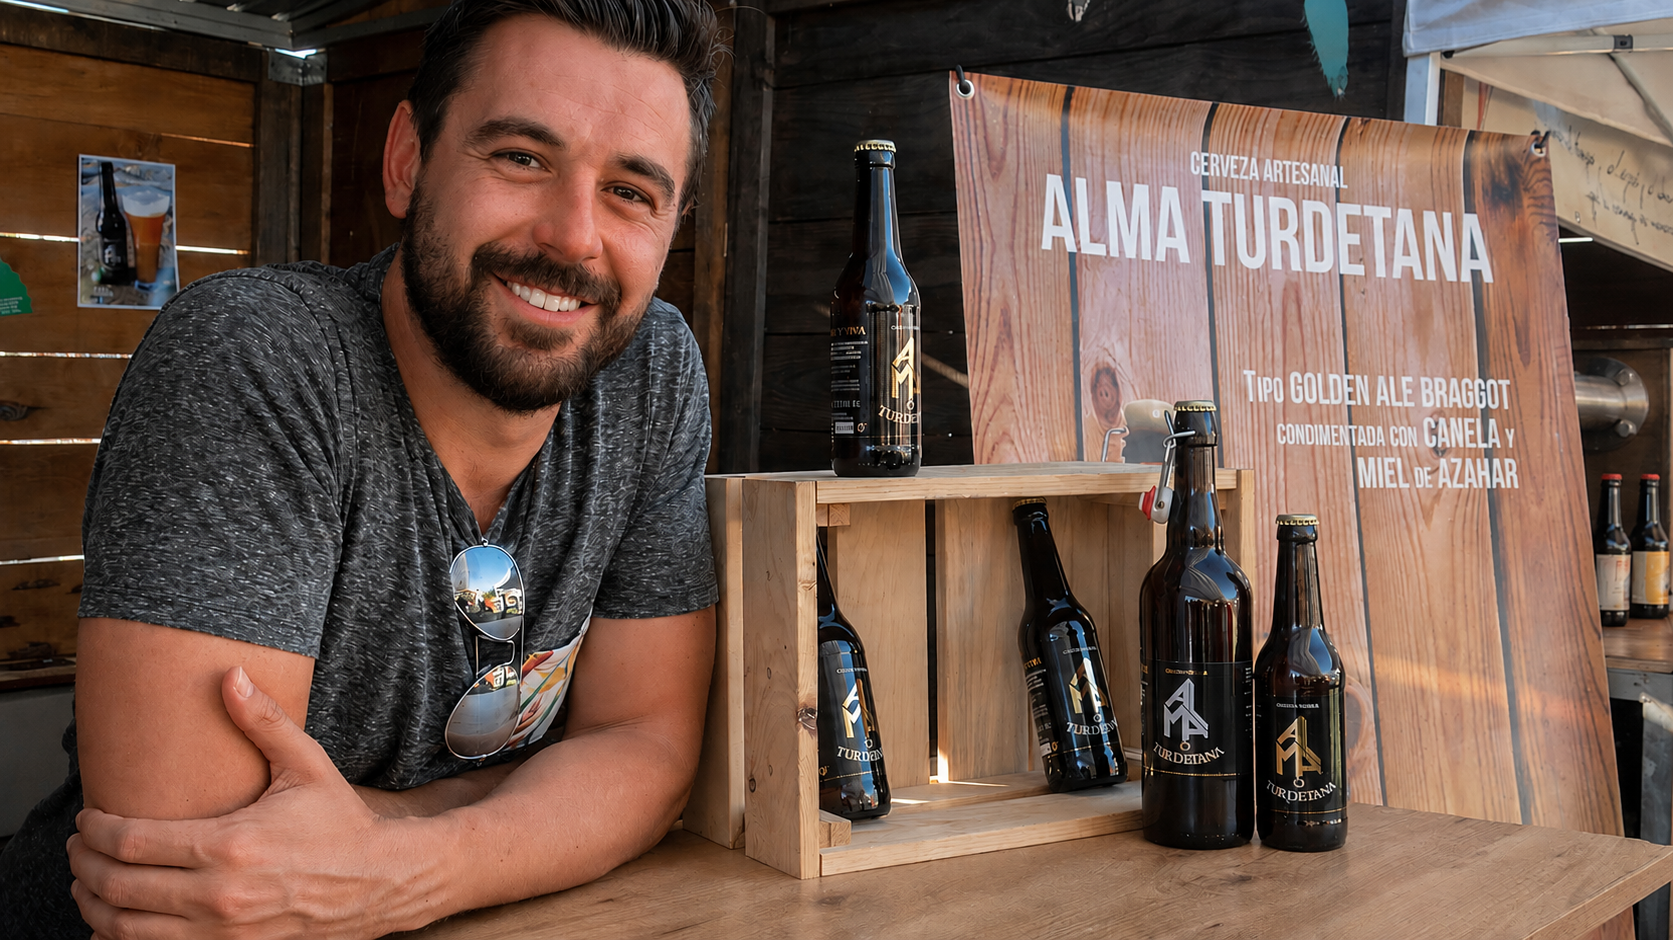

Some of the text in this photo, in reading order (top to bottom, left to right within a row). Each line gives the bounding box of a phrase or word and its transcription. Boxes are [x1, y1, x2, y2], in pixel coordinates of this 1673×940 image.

[1190, 151, 1348, 189] CERVEZA ARTESANAL
[1041, 173, 1190, 264] ALMA
[1201, 189, 1494, 283] TURDETANA
[1289, 371, 1370, 406] GOLDEN
[1376, 375, 1415, 407] ALE
[1420, 376, 1511, 410] BRAGGOT
[1276, 417, 1515, 448] CONDIMENTADA CON CANELA Y
[1357, 457, 1519, 489] MIEL DE AZAHAR
[1153, 742, 1226, 765] TURDETANA
[1266, 780, 1337, 804] TURDETANA
